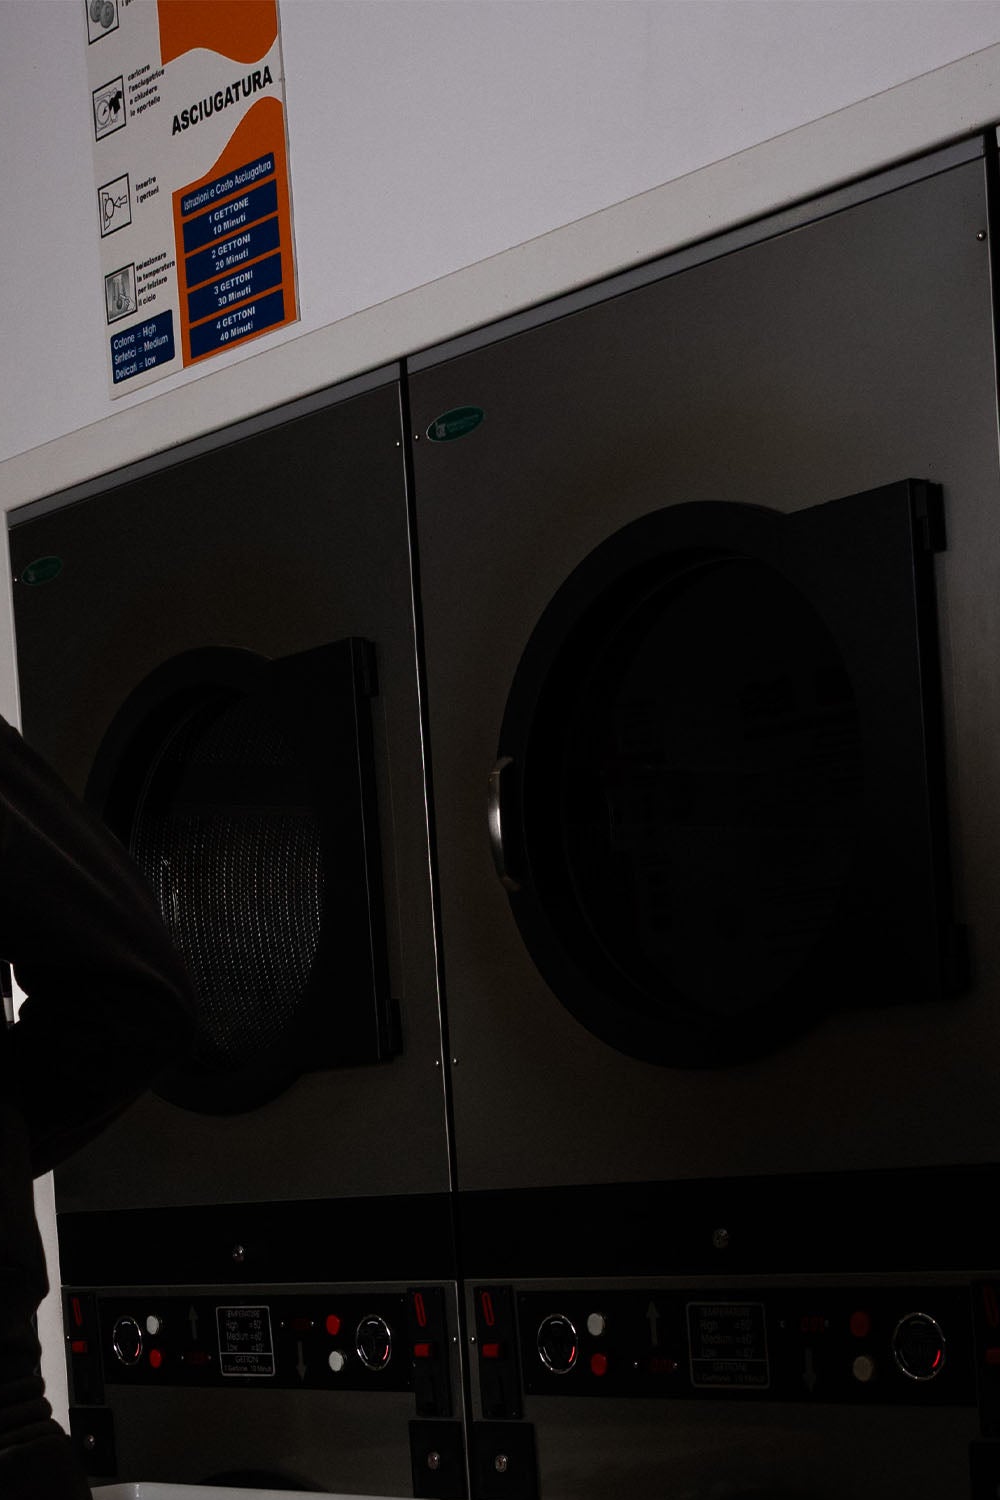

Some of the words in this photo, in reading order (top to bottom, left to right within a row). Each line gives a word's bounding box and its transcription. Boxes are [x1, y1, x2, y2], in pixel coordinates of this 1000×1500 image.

[172, 66, 272, 136] ASCIUGATURA
[184, 189, 209, 211] Istruzioni
[216, 180, 233, 194] Costo
[234, 161, 271, 186] Asciugatura
[214, 197, 249, 220] GETTONE
[213, 226, 222, 235] 10
[224, 212, 246, 230] Minuti
[212, 250, 216, 258] 2
[218, 233, 250, 256] GETTONI
[216, 260, 224, 270] 20
[226, 248, 249, 265] Minuti
[214, 286, 219, 295] 3
[220, 270, 253, 292] GETTONI
[218, 296, 226, 306] 30
[228, 285, 251, 302] Minuti
[217, 321, 221, 329] 4
[223, 306, 255, 328] GETTONI
[113, 334, 135, 350] Cotone
[220, 332, 229, 341] 40
[231, 320, 253, 337] Minuti
[144, 335, 168, 352] Medium
